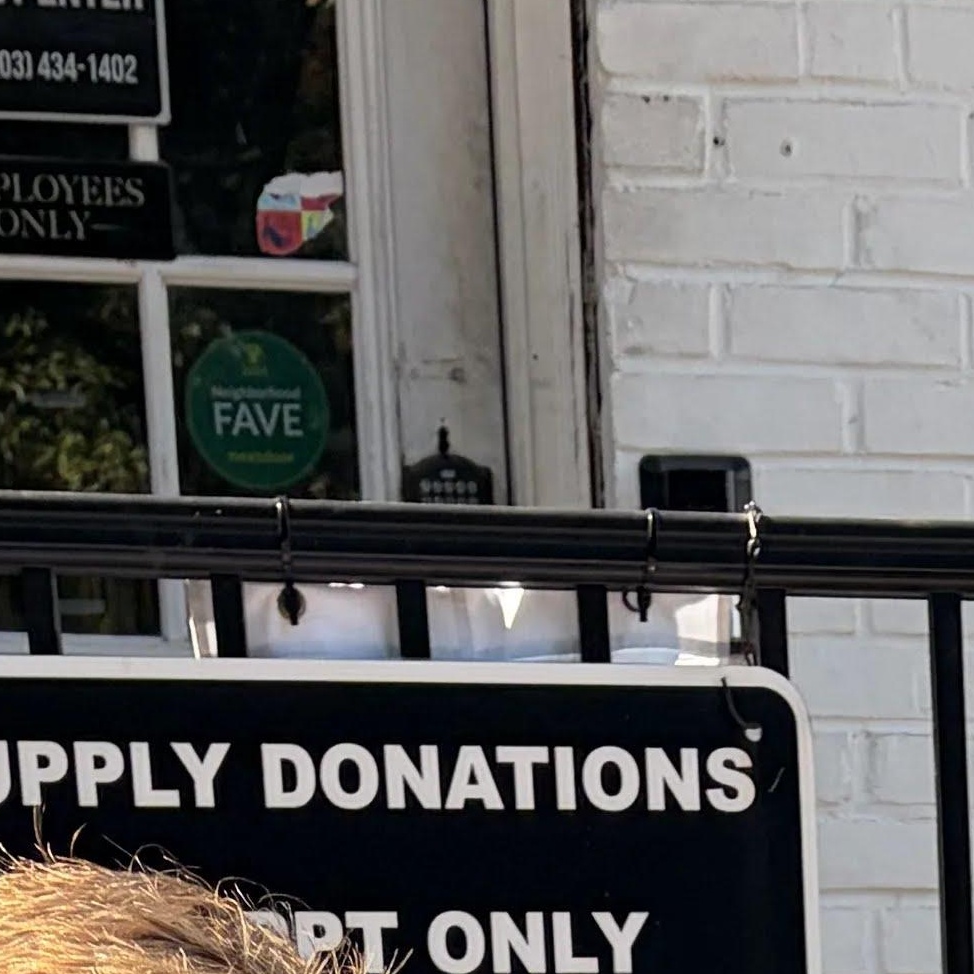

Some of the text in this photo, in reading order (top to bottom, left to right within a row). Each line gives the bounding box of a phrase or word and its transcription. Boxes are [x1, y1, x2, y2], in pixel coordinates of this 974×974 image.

[36, 51, 139, 84] 434-1402
[212, 401, 305, 438] FAVE
[261, 742, 757, 813] DONATIONS
[243, 910, 399, 974] PT
